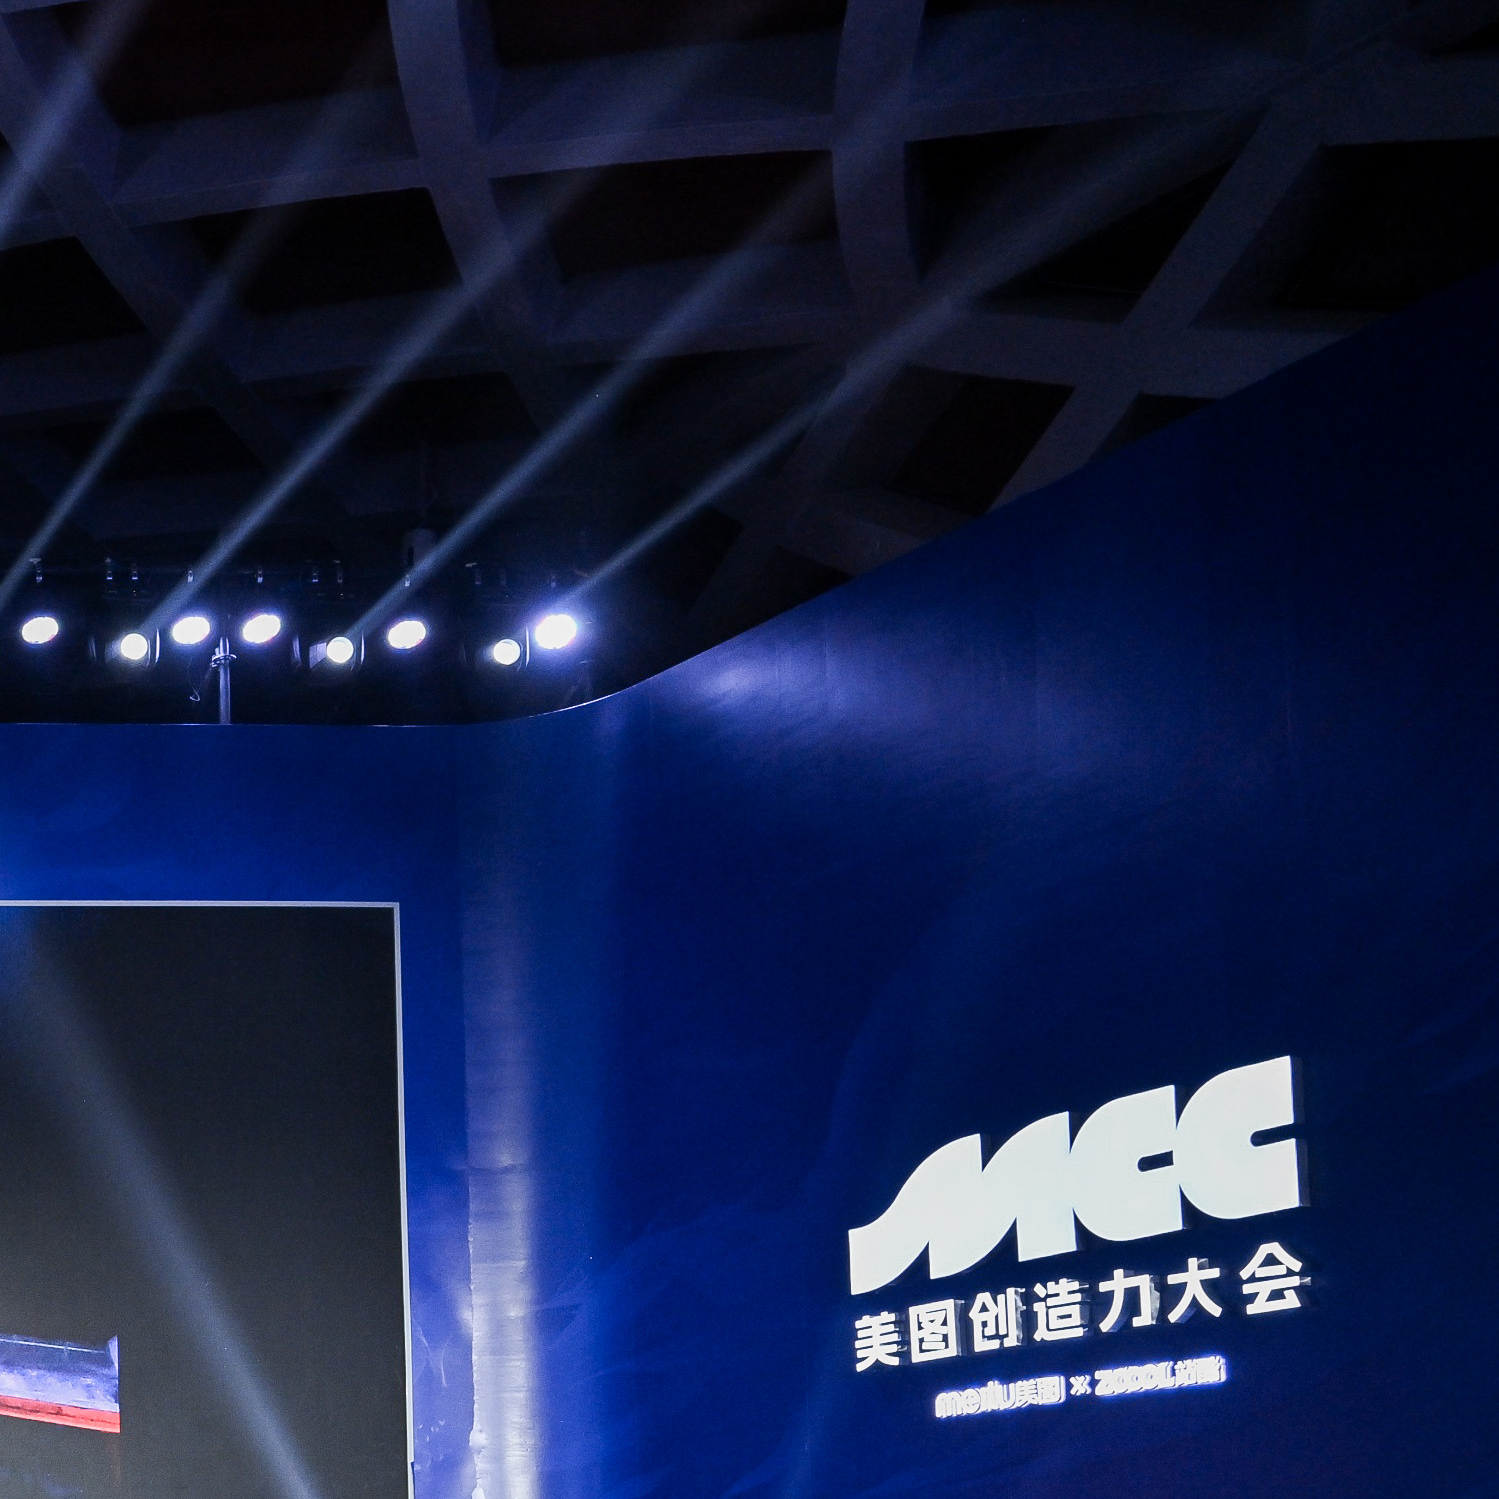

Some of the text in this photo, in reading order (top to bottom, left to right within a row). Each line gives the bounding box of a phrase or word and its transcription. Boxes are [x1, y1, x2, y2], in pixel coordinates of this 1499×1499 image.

[854, 1241, 1303, 1373] 美图创造力大会
